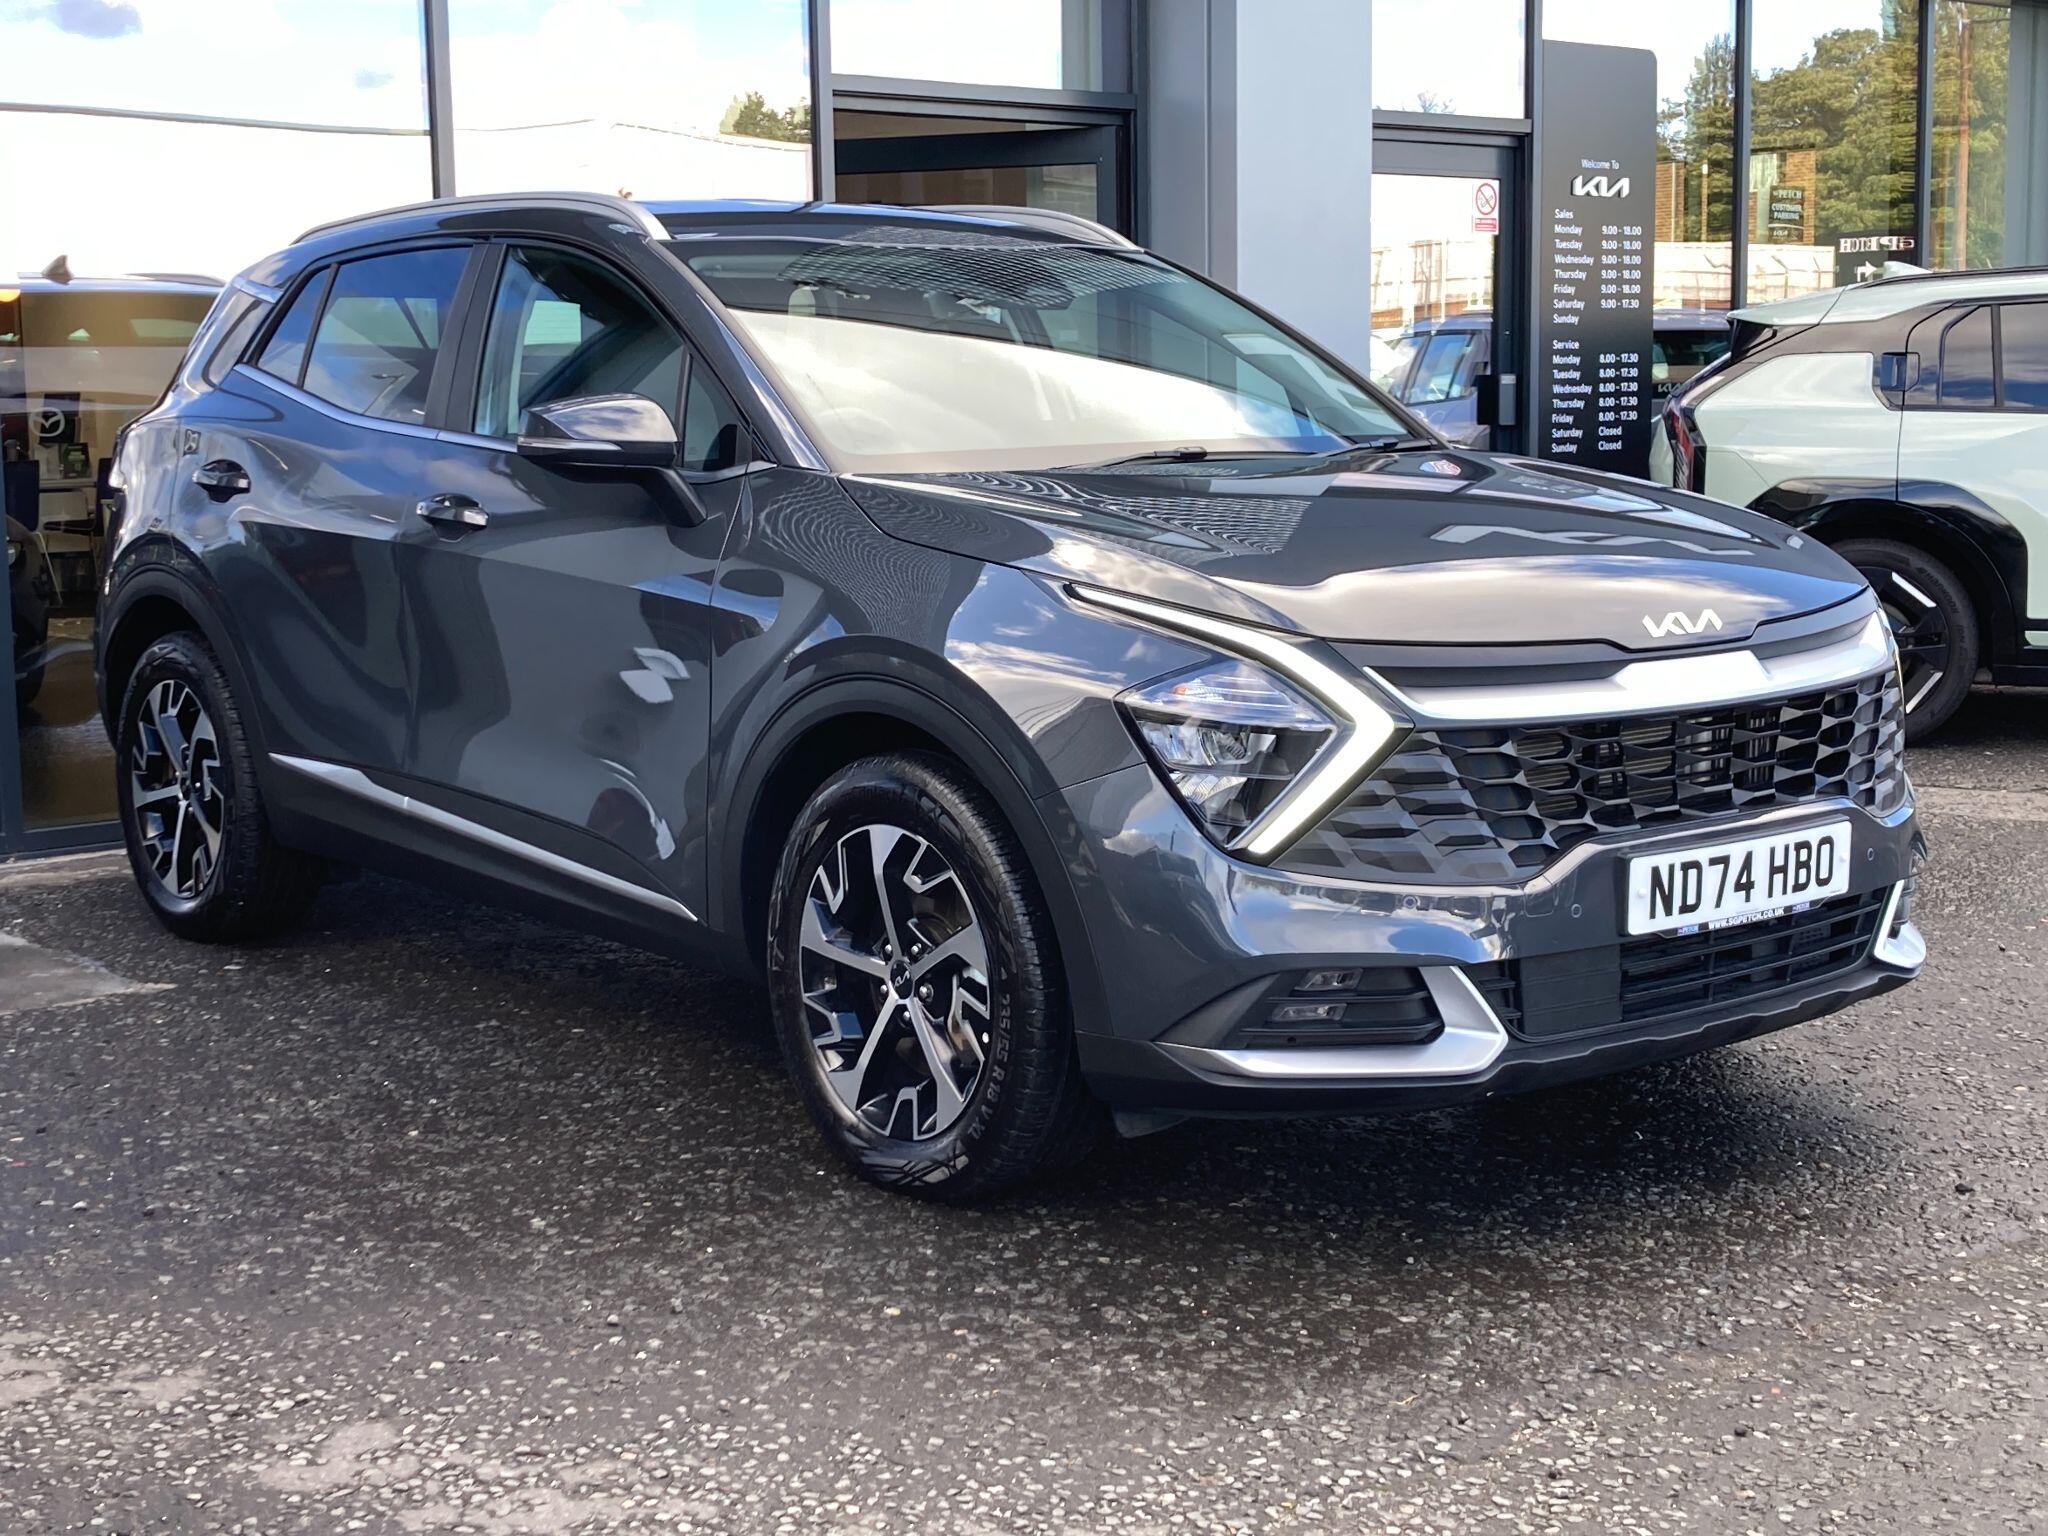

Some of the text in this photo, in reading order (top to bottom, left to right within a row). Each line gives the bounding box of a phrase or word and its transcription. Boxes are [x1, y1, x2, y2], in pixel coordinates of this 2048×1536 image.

[1581, 159, 1620, 169] Welcome To
[1571, 175, 1630, 198] KIA
[1554, 208, 1574, 219] Sales
[1554, 224, 1583, 236] Monday
[1601, 225, 1617, 235] 9.00
[1554, 239, 1583, 251] Tuesday
[1601, 240, 1617, 249] 9.00
[1554, 254, 1594, 266] Wednesday
[1601, 255, 1617, 264] 9.00
[1554, 269, 1587, 281] Thursday
[1601, 269, 1617, 279] 9.00
[1553, 284, 1576, 296] Friday
[1601, 284, 1616, 294] 9.00
[1553, 299, 1585, 310] Saturday
[1601, 299, 1616, 308] 9.00
[1553, 313, 1580, 325] Sunday
[1552, 340, 1580, 350] Service
[1552, 354, 1581, 366] Monday
[1599, 353, 1615, 363] 8.00
[1552, 369, 1581, 381] Tuesday
[1599, 368, 1615, 378] 8.00
[1552, 383, 1593, 395] Wednesday
[1599, 382, 1615, 392] 8.00
[1552, 398, 1585, 410] Thursday
[1599, 397, 1615, 407] 8.00
[1552, 413, 1574, 425] Friday
[1599, 411, 1615, 421] 8.00
[1552, 425, 1622, 439] Saturday Closed
[1552, 440, 1622, 454] Sunday Closed
[1642, 608, 1723, 638] KIA
[1649, 835, 1834, 920] ND74 HBO
